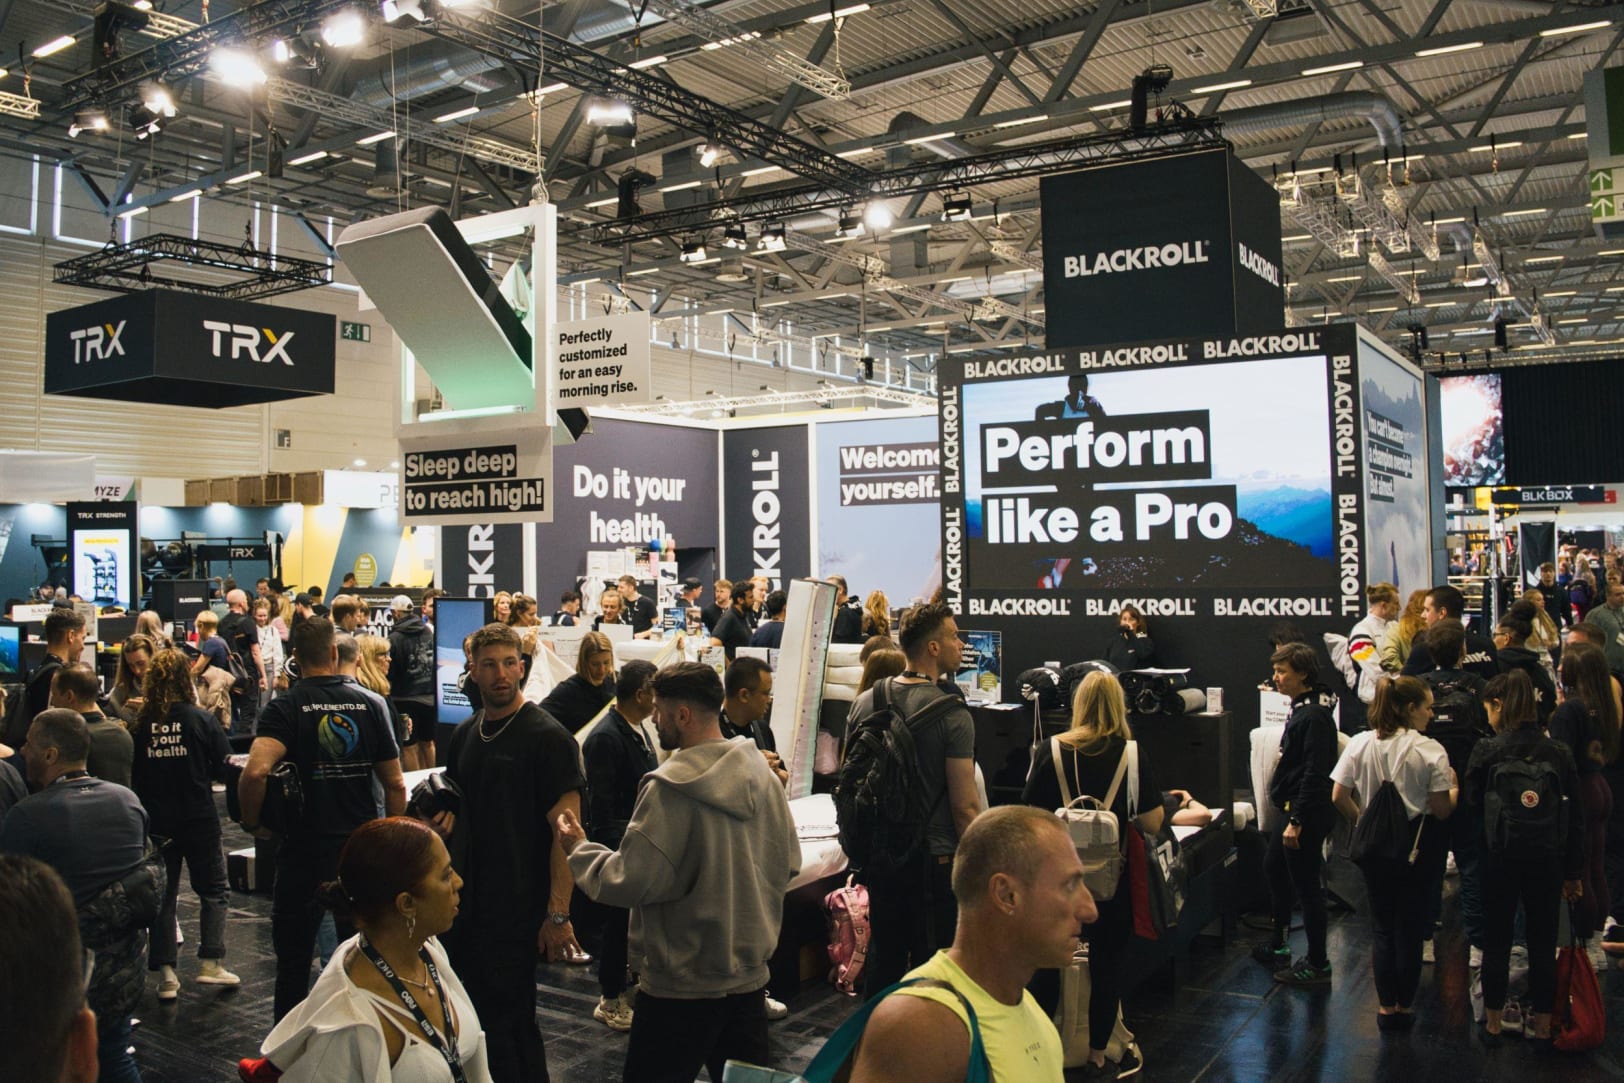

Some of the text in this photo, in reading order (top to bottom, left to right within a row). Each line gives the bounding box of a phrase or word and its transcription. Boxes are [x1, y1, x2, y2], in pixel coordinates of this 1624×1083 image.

[1064, 241, 1208, 278] BLACKROLL
[1239, 242, 1279, 287] BLACKROLL
[70, 320, 126, 364] TRX
[203, 320, 295, 366] TRX
[559, 328, 612, 346] Perfectly
[1203, 333, 1320, 359] BLACKROLL
[559, 344, 627, 363] customized
[1080, 345, 1188, 369] BLACKROLL
[559, 364, 622, 381] for an easy
[964, 357, 1065, 379] BLACKROLL
[559, 380, 637, 399] morning rise.
[1332, 355, 1356, 478] BLACKROLL
[943, 386, 960, 493] BLACKROLL
[985, 421, 1205, 473] Perform
[405, 451, 516, 480] Sleep deep
[405, 480, 543, 511] to reach high!
[573, 465, 686, 506] Do it your
[841, 476, 940, 505] yourself.
[1521, 490, 1573, 502] BLK BOX
[590, 511, 673, 543] health.
[987, 492, 1233, 544] like a Pro
[228, 548, 255, 558] TRX
[946, 508, 963, 615] BLACKROLL
[1338, 494, 1360, 617] BLACKROLL
[969, 598, 1071, 616] BLACKROLL
[1086, 598, 1195, 616] BLACKROLL
[1214, 598, 1333, 617] BLACKROLL
[152, 722, 181, 734] Do it
[152, 735, 181, 747] your
[147, 745, 187, 758] health
